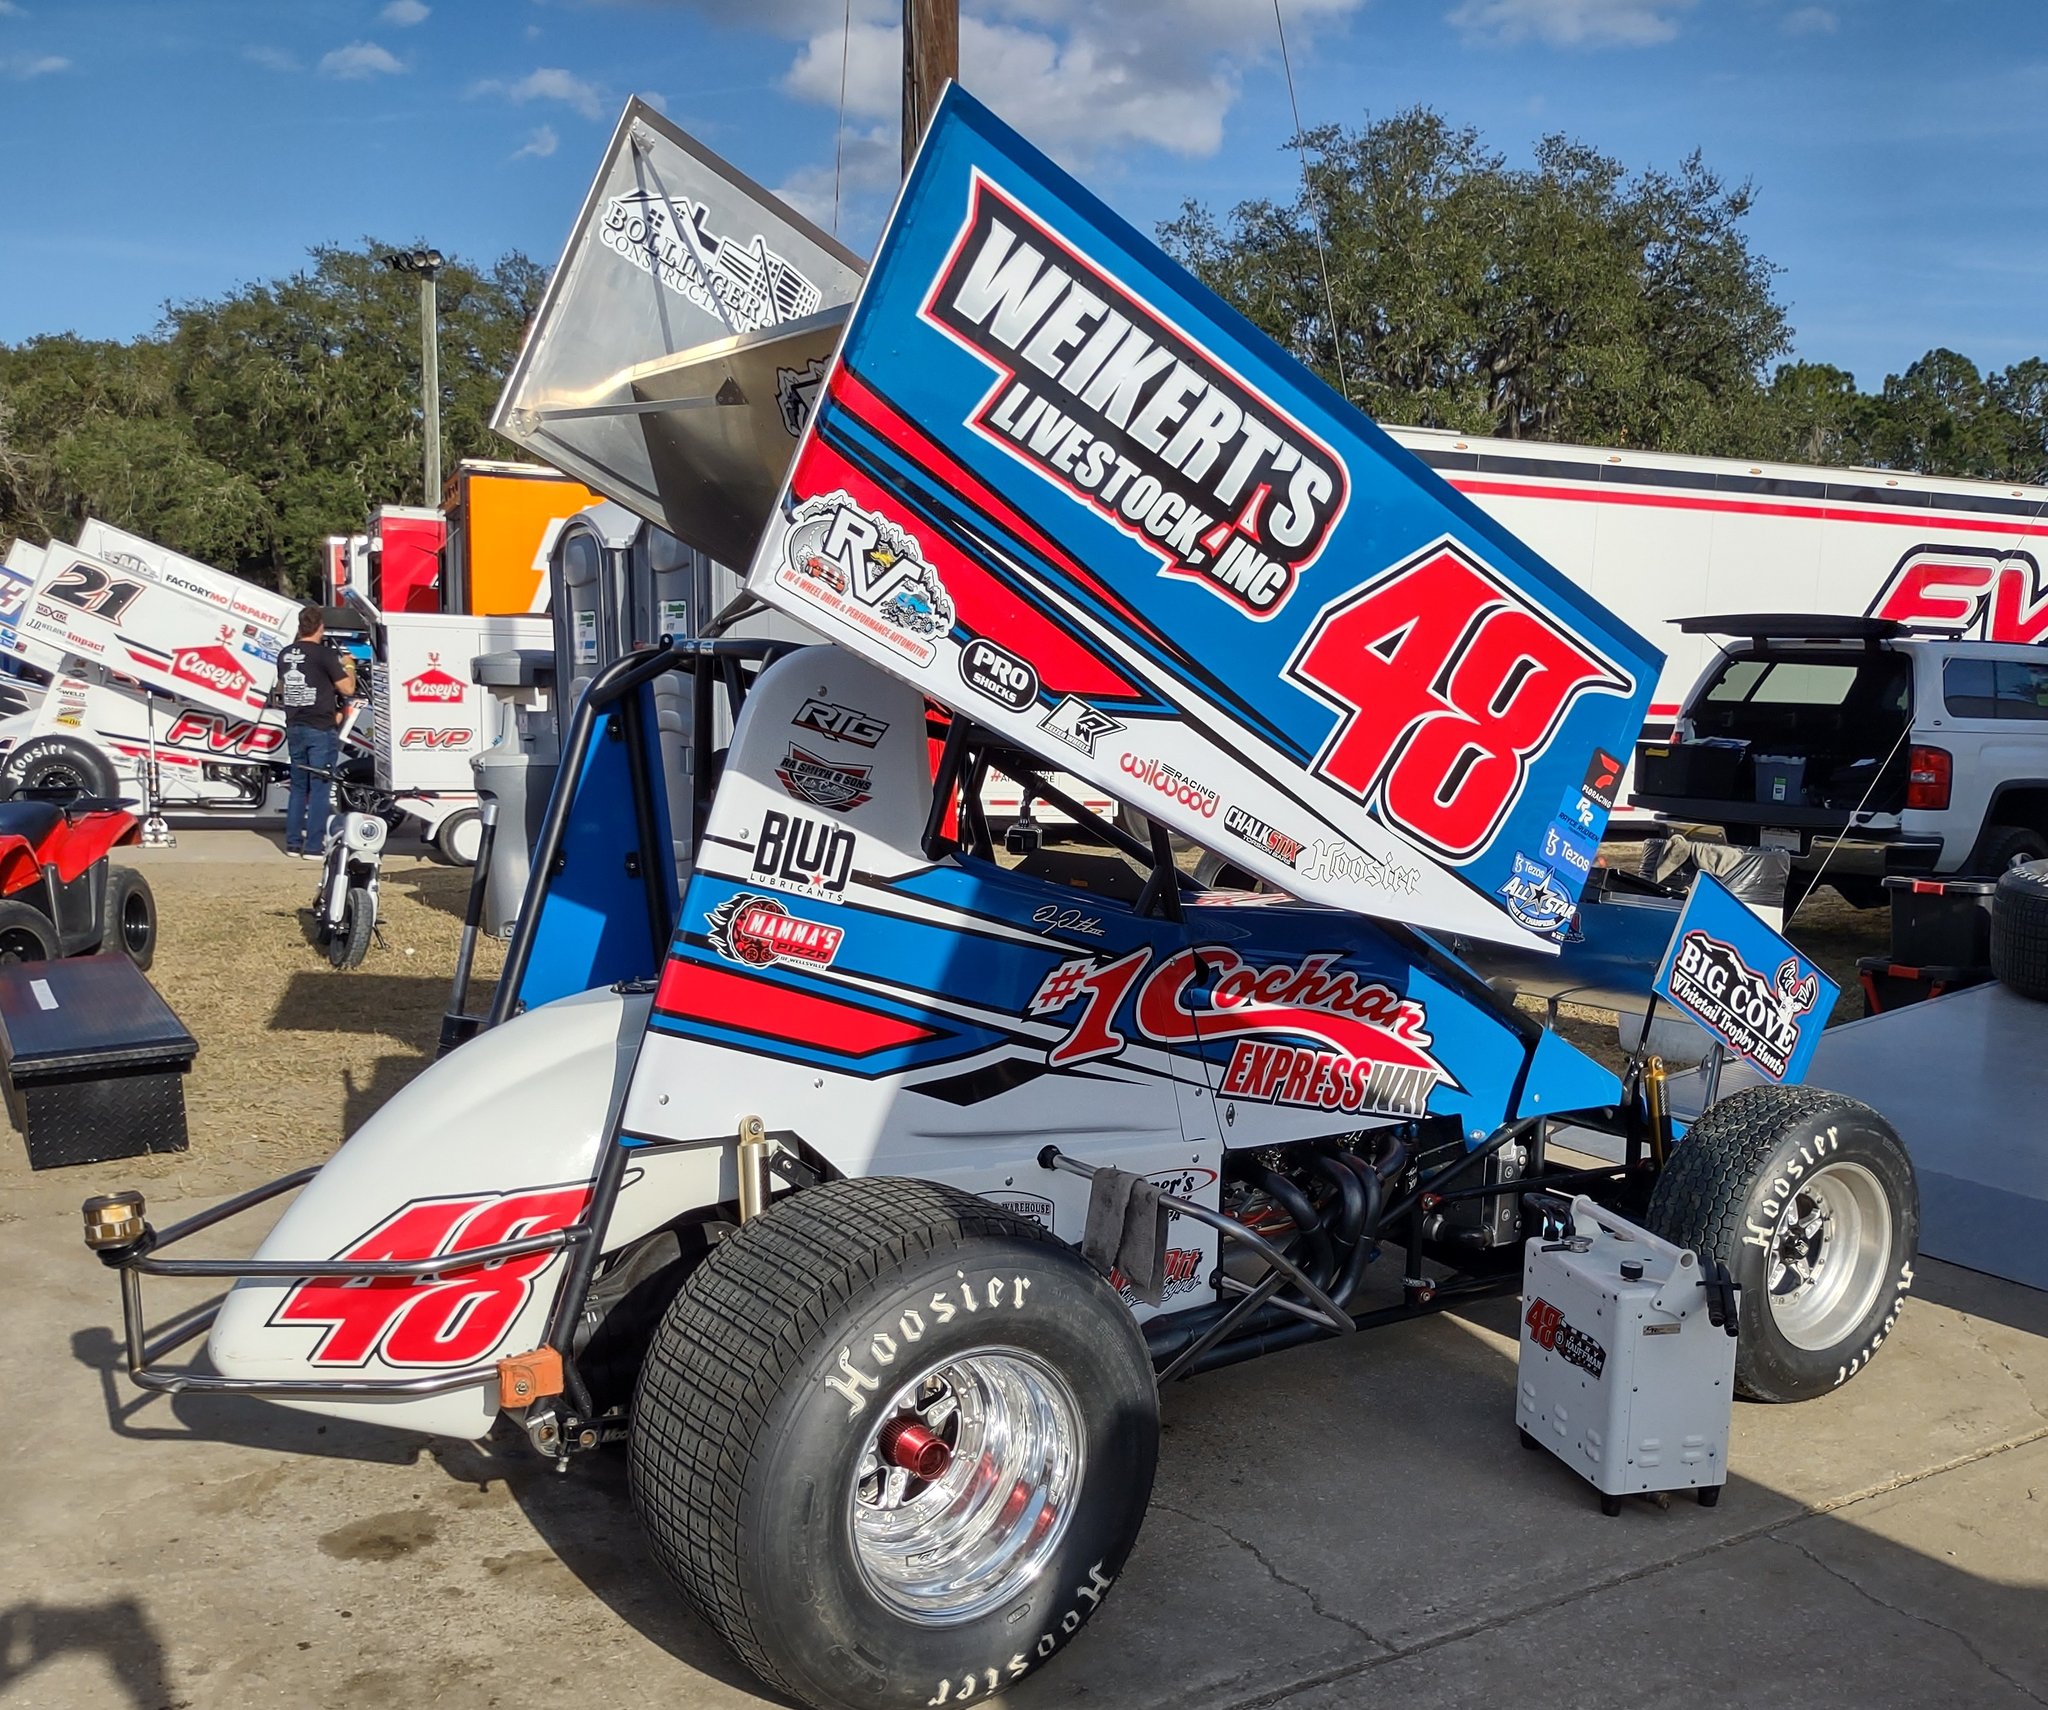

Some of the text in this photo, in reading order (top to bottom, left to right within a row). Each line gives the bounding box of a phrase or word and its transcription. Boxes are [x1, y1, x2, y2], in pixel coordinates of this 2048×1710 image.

[602, 228, 749, 333] CONSTRUCTION
[605, 201, 762, 323] BOLLINGER
[953, 217, 1333, 548] WEIKERT'S
[990, 382, 1288, 607] LIVESTOCK, INC
[36, 603, 68, 624] MAXIM
[42, 561, 144, 625] 21
[166, 574, 280, 626] FACTORYMOORPARTS
[798, 577, 822, 598] WHEEL
[821, 592, 843, 610] DRIVE
[845, 605, 892, 639] PERFORMANCE
[888, 631, 930, 660] AUTOMOTIVE
[67, 632, 106, 652] Impact
[972, 645, 1029, 691] PRO
[179, 651, 246, 691] Casey's
[410, 679, 461, 700] Casey's
[973, 671, 1017, 703] SHOCKS
[1283, 538, 1633, 864] 48
[166, 709, 287, 757] FVP
[400, 728, 473, 748] FVP
[6, 742, 67, 786] Hoosier
[780, 758, 798, 769] RA
[797, 762, 833, 780] SMITH
[843, 775, 872, 791] SONS
[1120, 752, 1220, 819] wilwood
[1174, 770, 1216, 800] RACING
[1559, 811, 1577, 827] RAYCE
[1582, 784, 1612, 808] FLORACING
[1302, 838, 1421, 895] Hoosier
[1525, 861, 1545, 879] Tezos
[1561, 841, 1590, 871] Tezos
[750, 873, 844, 902] LUBRICANTS
[1502, 876, 1577, 919] ALL STAR
[749, 914, 837, 950] MAMMA'S
[776, 942, 829, 960] PIZZA
[1028, 946, 1430, 1068] #1 Cochran
[1672, 970, 1786, 1076] Whitetail Trophy Hunts
[1677, 939, 1798, 1055] BIG COVE
[1222, 1040, 1439, 1119] EXPRESSWAY
[1742, 1126, 1839, 1257] Hoosier
[265, 1190, 595, 1368] 48
[825, 1269, 1032, 1423] Hoosier
[1526, 1297, 1565, 1352] 48
[1834, 1260, 1914, 1386] Hoosier
[927, 1561, 1117, 1707] Hoosier
